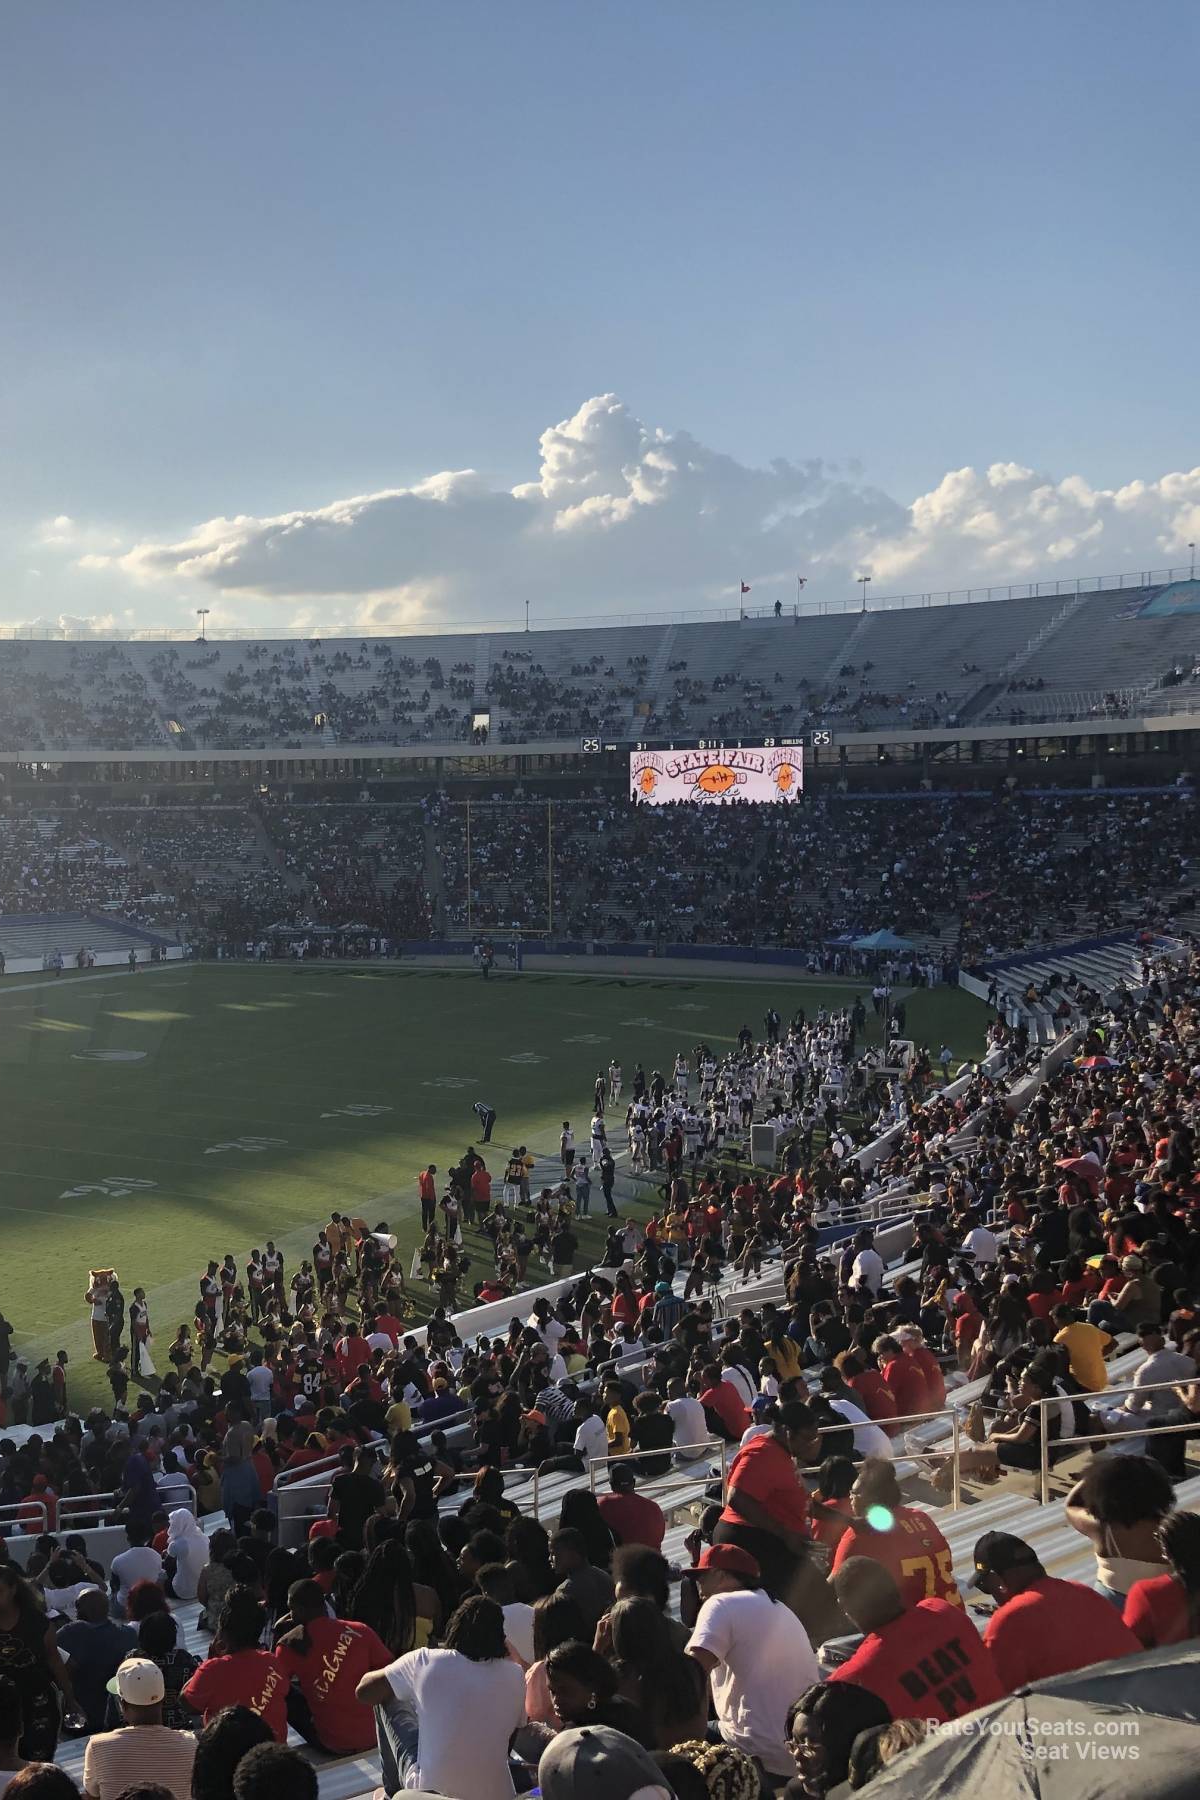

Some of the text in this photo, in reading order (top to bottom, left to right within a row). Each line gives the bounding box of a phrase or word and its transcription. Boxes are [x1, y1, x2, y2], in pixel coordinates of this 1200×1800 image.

[583, 739, 599, 751] 25
[764, 738, 775, 747] 23
[813, 731, 830, 745] 25
[665, 750, 765, 778] STATE FAIR
[684, 772, 748, 784] 20 19
[73, 1176, 159, 1197] 20
[303, 1372, 322, 1395] 84
[898, 1637, 972, 1702] BEAT
[936, 1675, 976, 1718] PV
